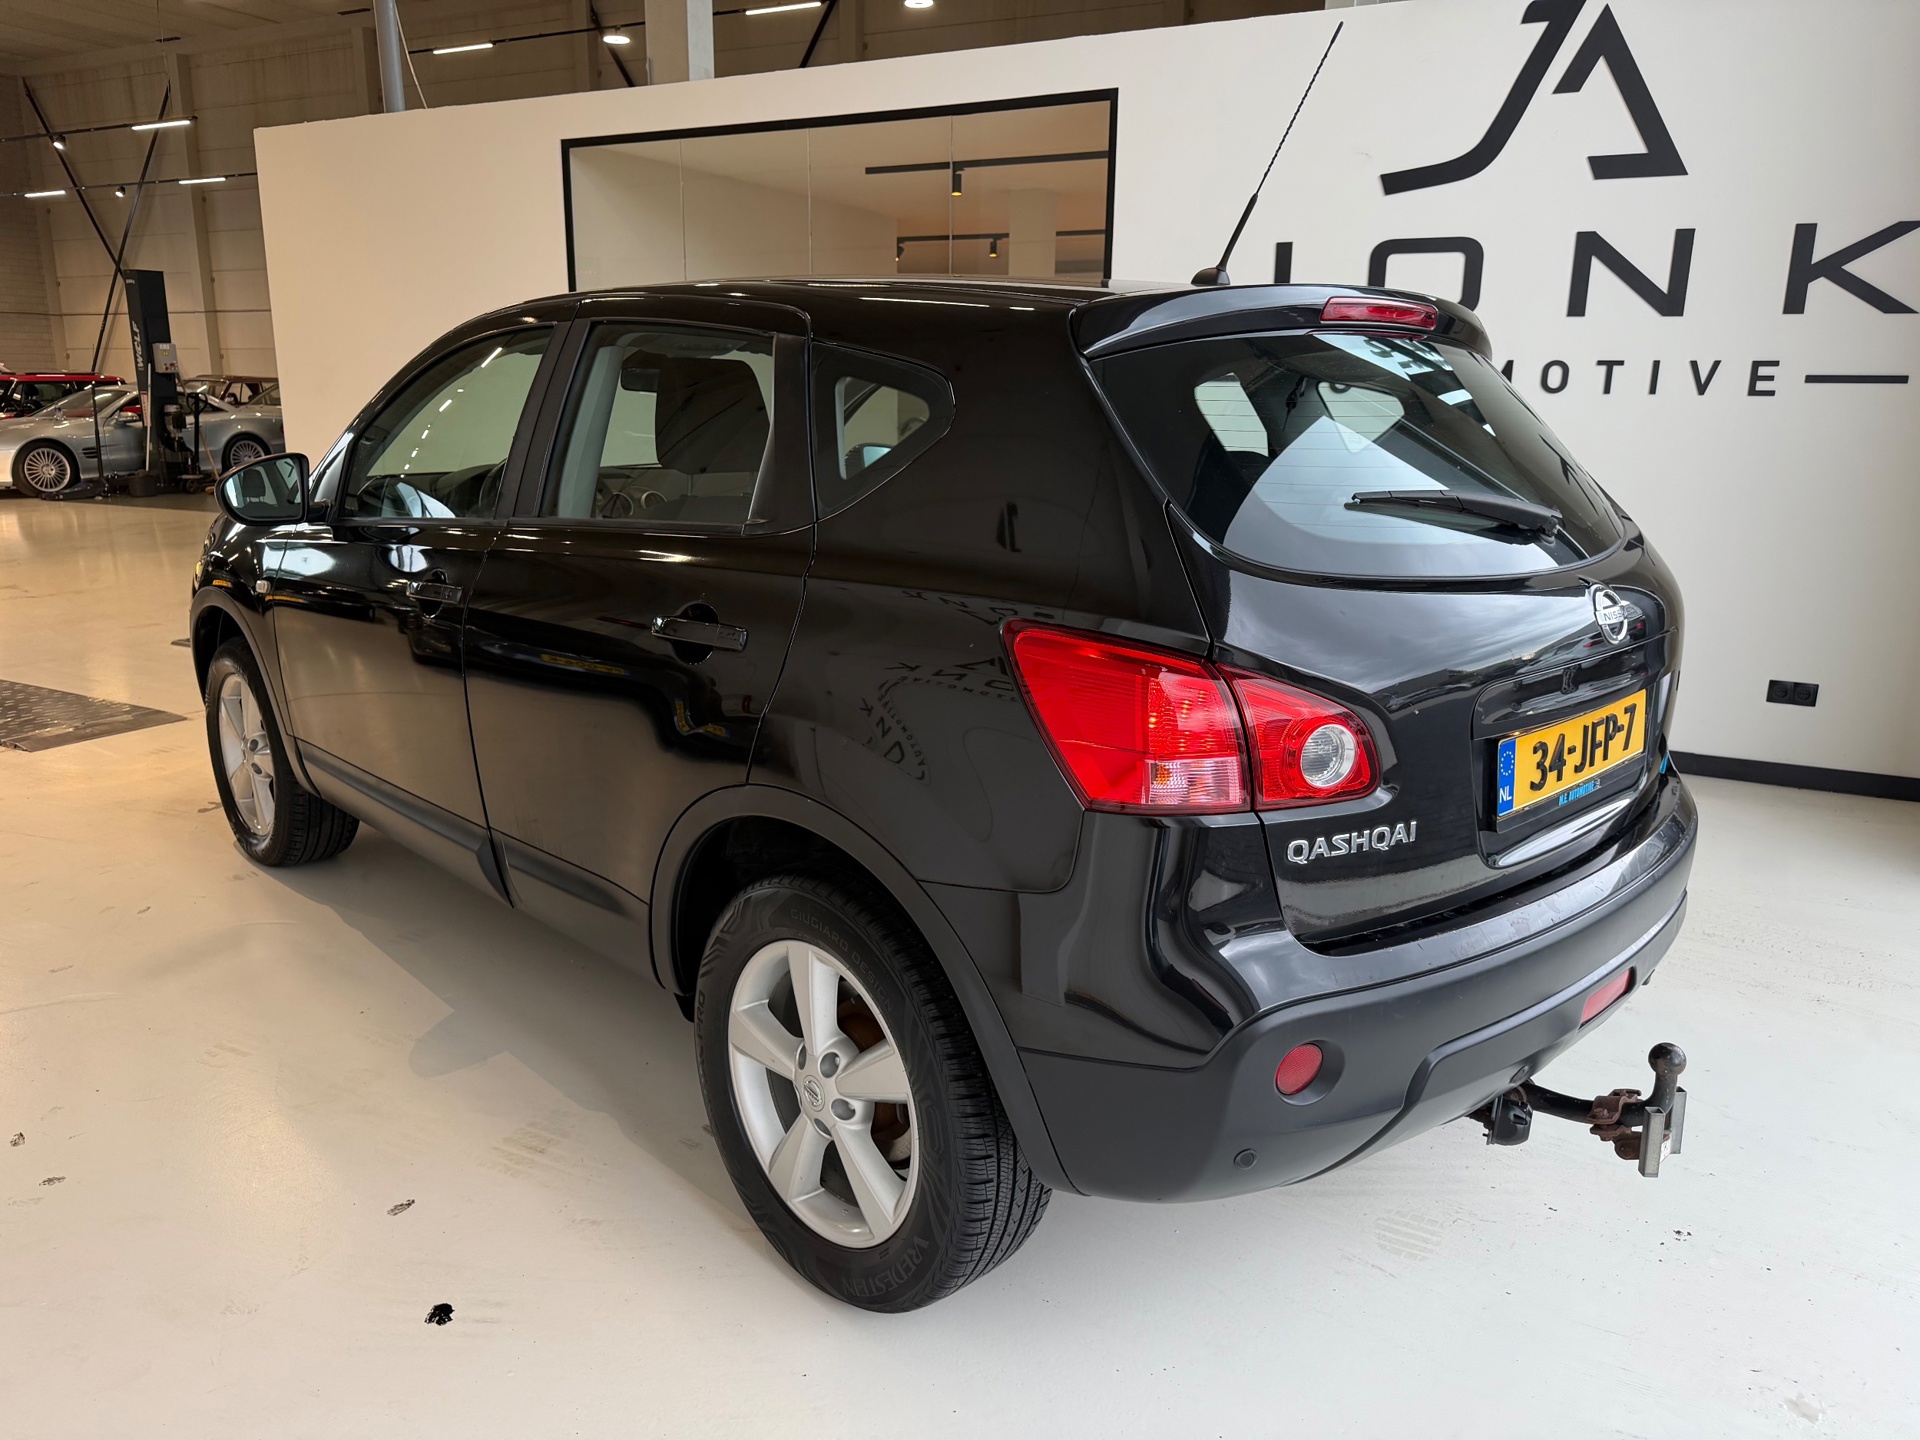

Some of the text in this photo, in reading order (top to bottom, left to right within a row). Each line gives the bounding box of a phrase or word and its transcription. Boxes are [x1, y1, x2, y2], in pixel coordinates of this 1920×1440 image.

[1529, 702, 1637, 792] 34-JFP-7
[1499, 785, 1512, 804] NL
[1287, 821, 1418, 865] QASHQAI
[790, 908, 894, 1012] GIUGIARO DESIGN
